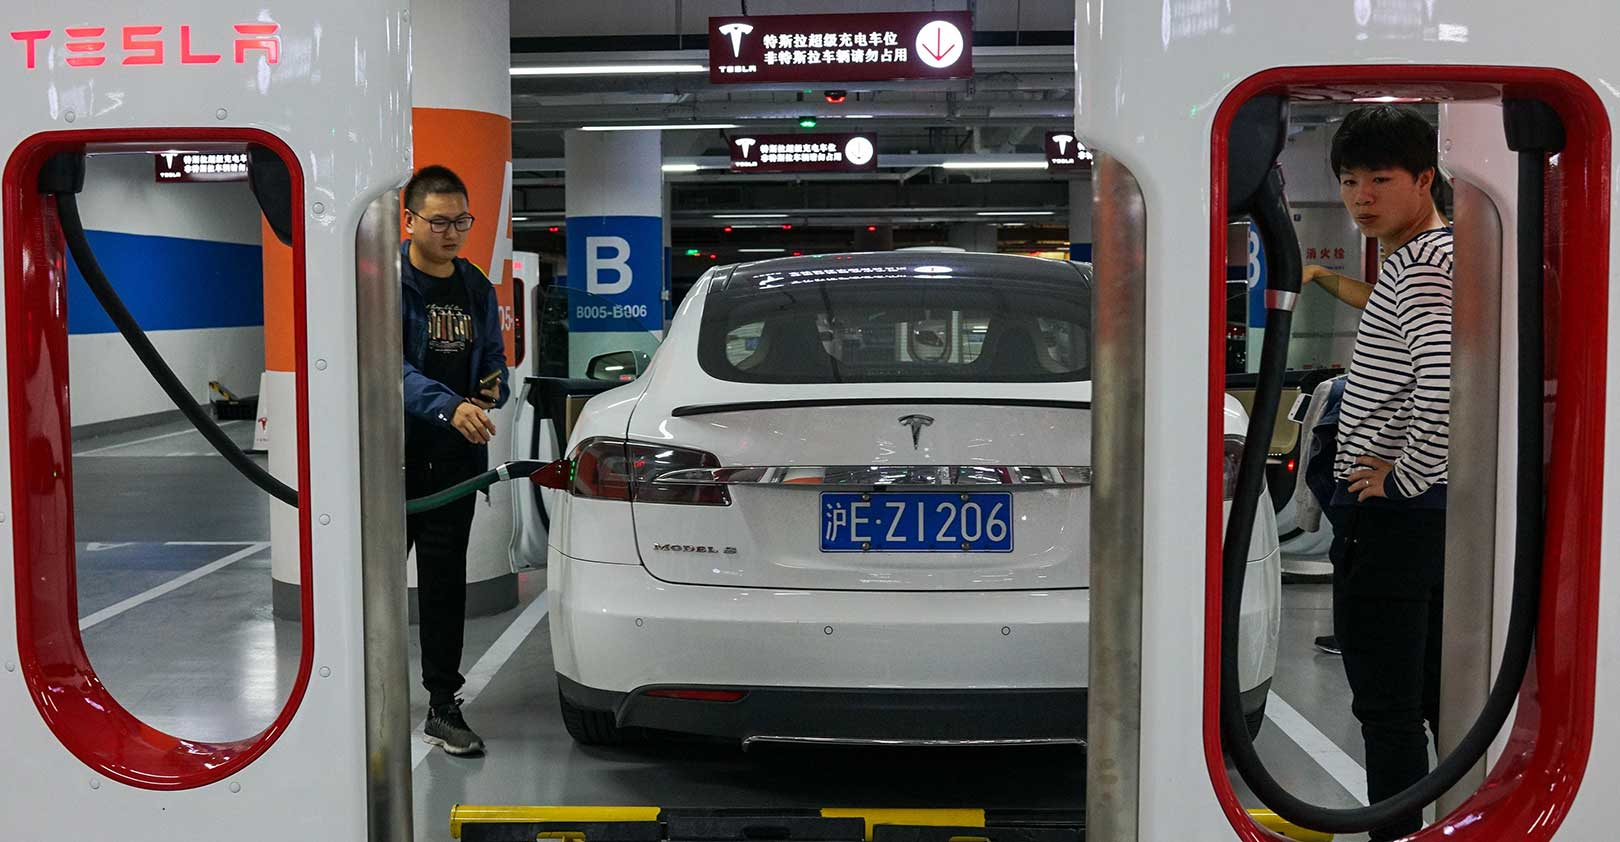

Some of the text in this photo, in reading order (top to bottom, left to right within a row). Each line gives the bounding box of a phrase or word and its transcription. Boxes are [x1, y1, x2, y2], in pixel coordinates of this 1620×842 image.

[9, 24, 280, 69] TESLA
[763, 31, 899, 48] 特斯拉超级充电车位
[763, 48, 907, 65] 非特斯拉车辆请勿占用
[718, 65, 757, 73] TESLA
[586, 236, 633, 295] B
[576, 304, 647, 318] B005-B006
[653, 543, 737, 554] MODEL S
